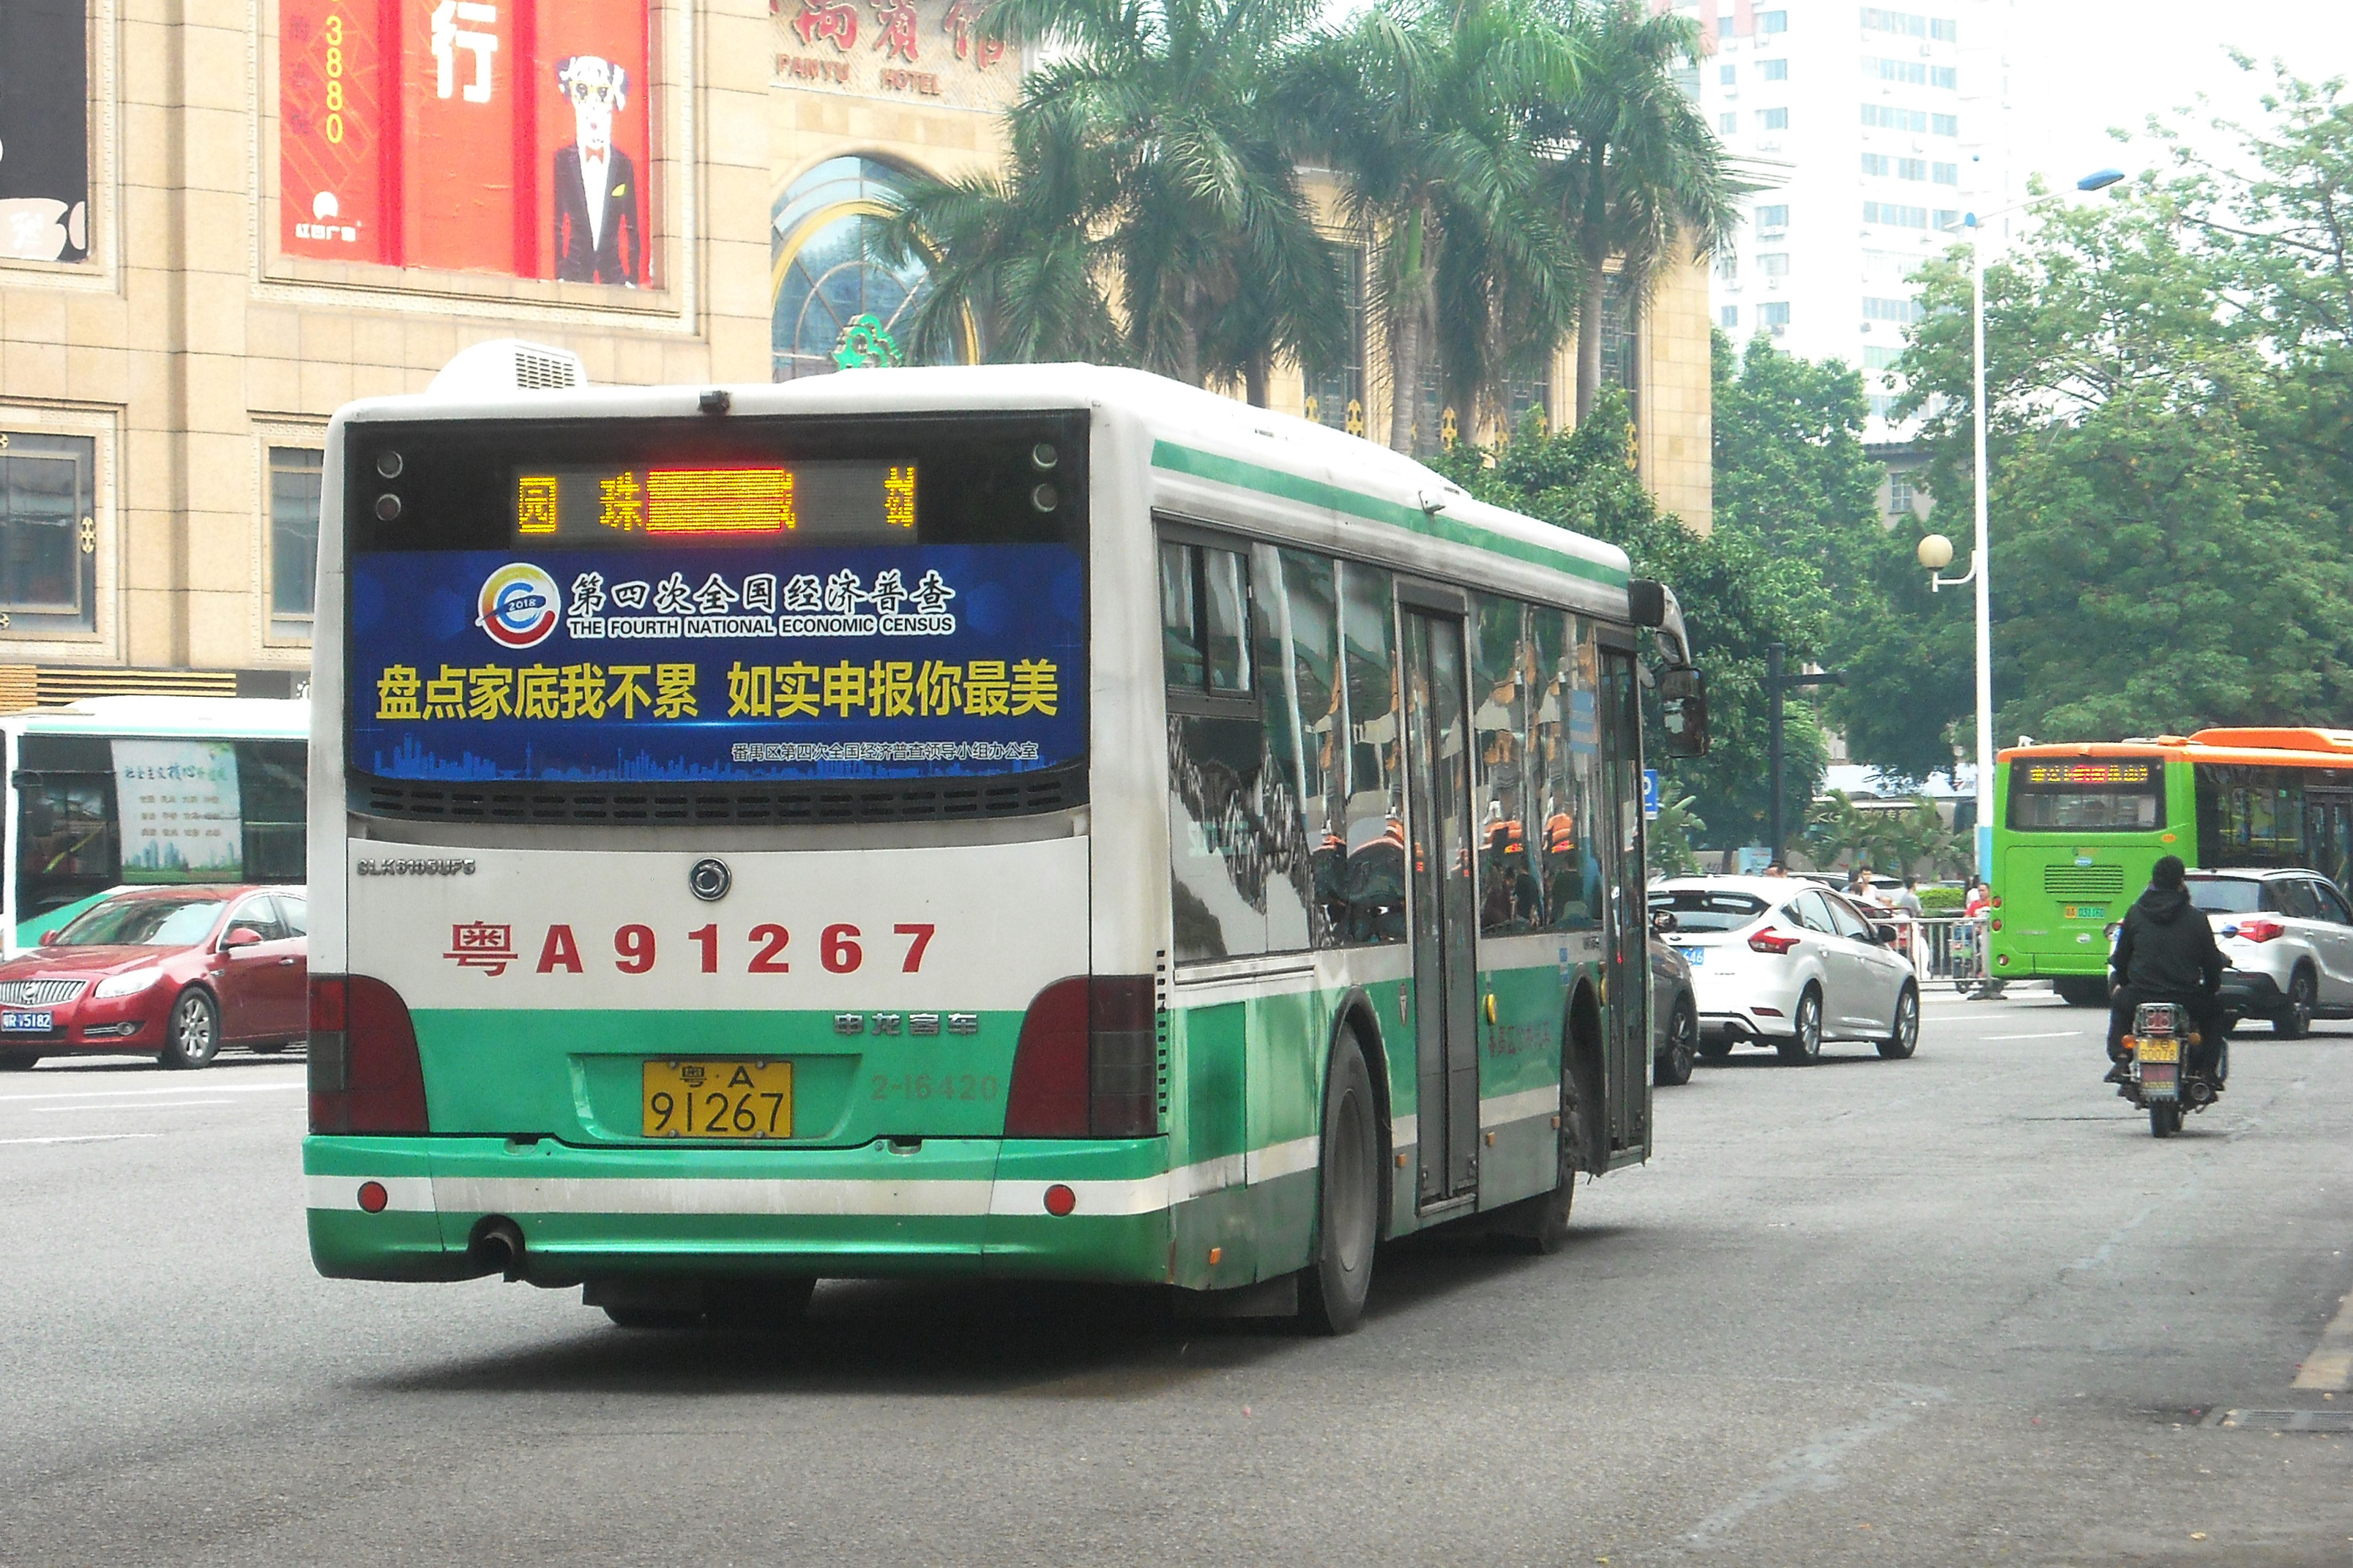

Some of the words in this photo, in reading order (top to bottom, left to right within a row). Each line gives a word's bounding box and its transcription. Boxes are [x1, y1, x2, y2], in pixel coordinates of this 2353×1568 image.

[776, 53, 850, 83] PANYU
[881, 67, 942, 94] HOTEL
[508, 598, 537, 611] 2018
[573, 571, 954, 616] 第四次全国经济普查
[570, 621, 603, 636] THE
[610, 620, 679, 635] FOURTH
[687, 619, 775, 635] NATIONAL
[782, 618, 875, 634] ECONOMIC
[882, 616, 953, 632] CENSUS
[376, 662, 699, 720] 盘点家底我不累
[727, 659, 1059, 718] 如实申报你最美
[732, 742, 1039, 762] 番禺区第四次全国经济普查领导小组办公室
[650, 1091, 784, 1132] 91267
